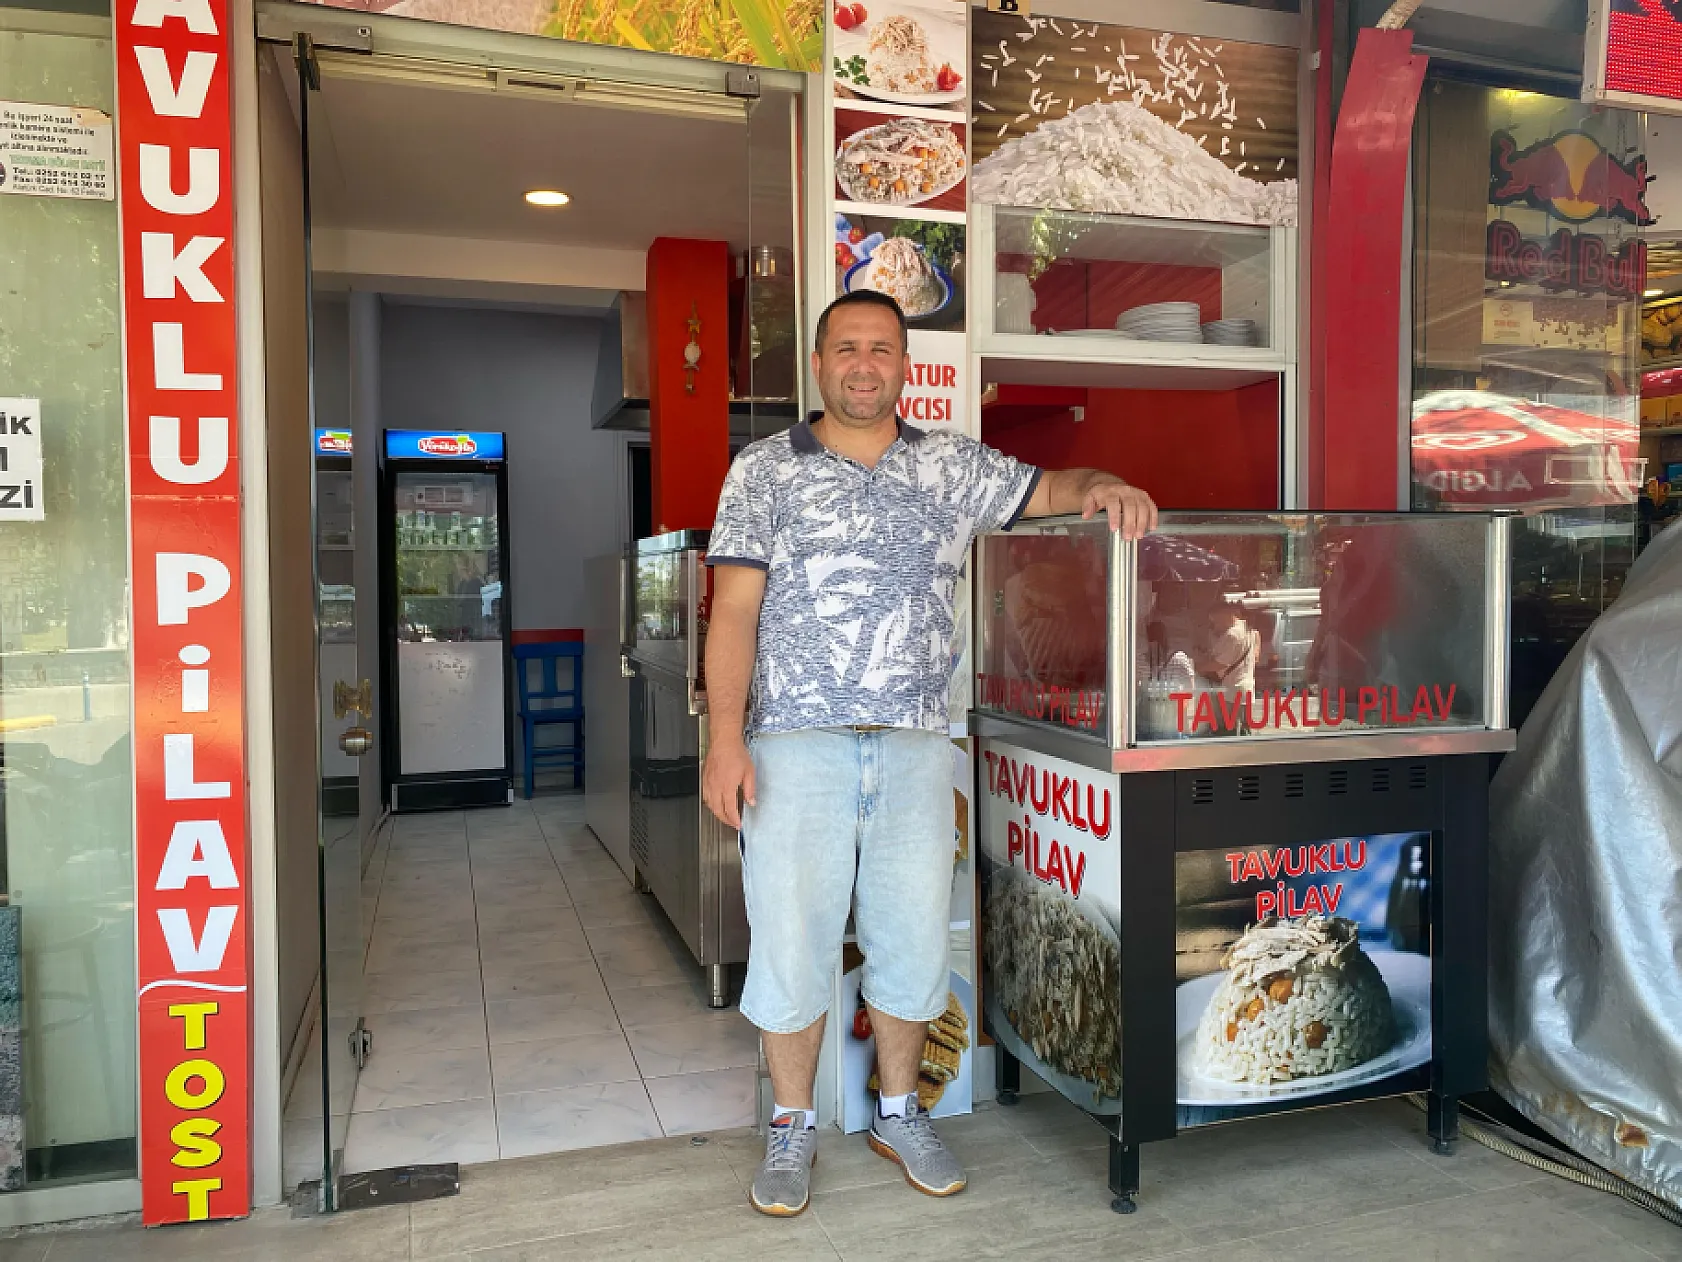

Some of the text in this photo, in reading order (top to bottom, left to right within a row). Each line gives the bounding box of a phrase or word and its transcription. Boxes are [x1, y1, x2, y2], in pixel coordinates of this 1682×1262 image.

[1491, 222, 1648, 296] Red Bull
[1168, 687, 1346, 733] TAVUKLU
[983, 750, 1112, 841] TAVUKLU
[1225, 839, 1367, 884] TAVUKLU
[1256, 879, 1344, 921] PİLAV
[164, 1001, 227, 1221] TOST
